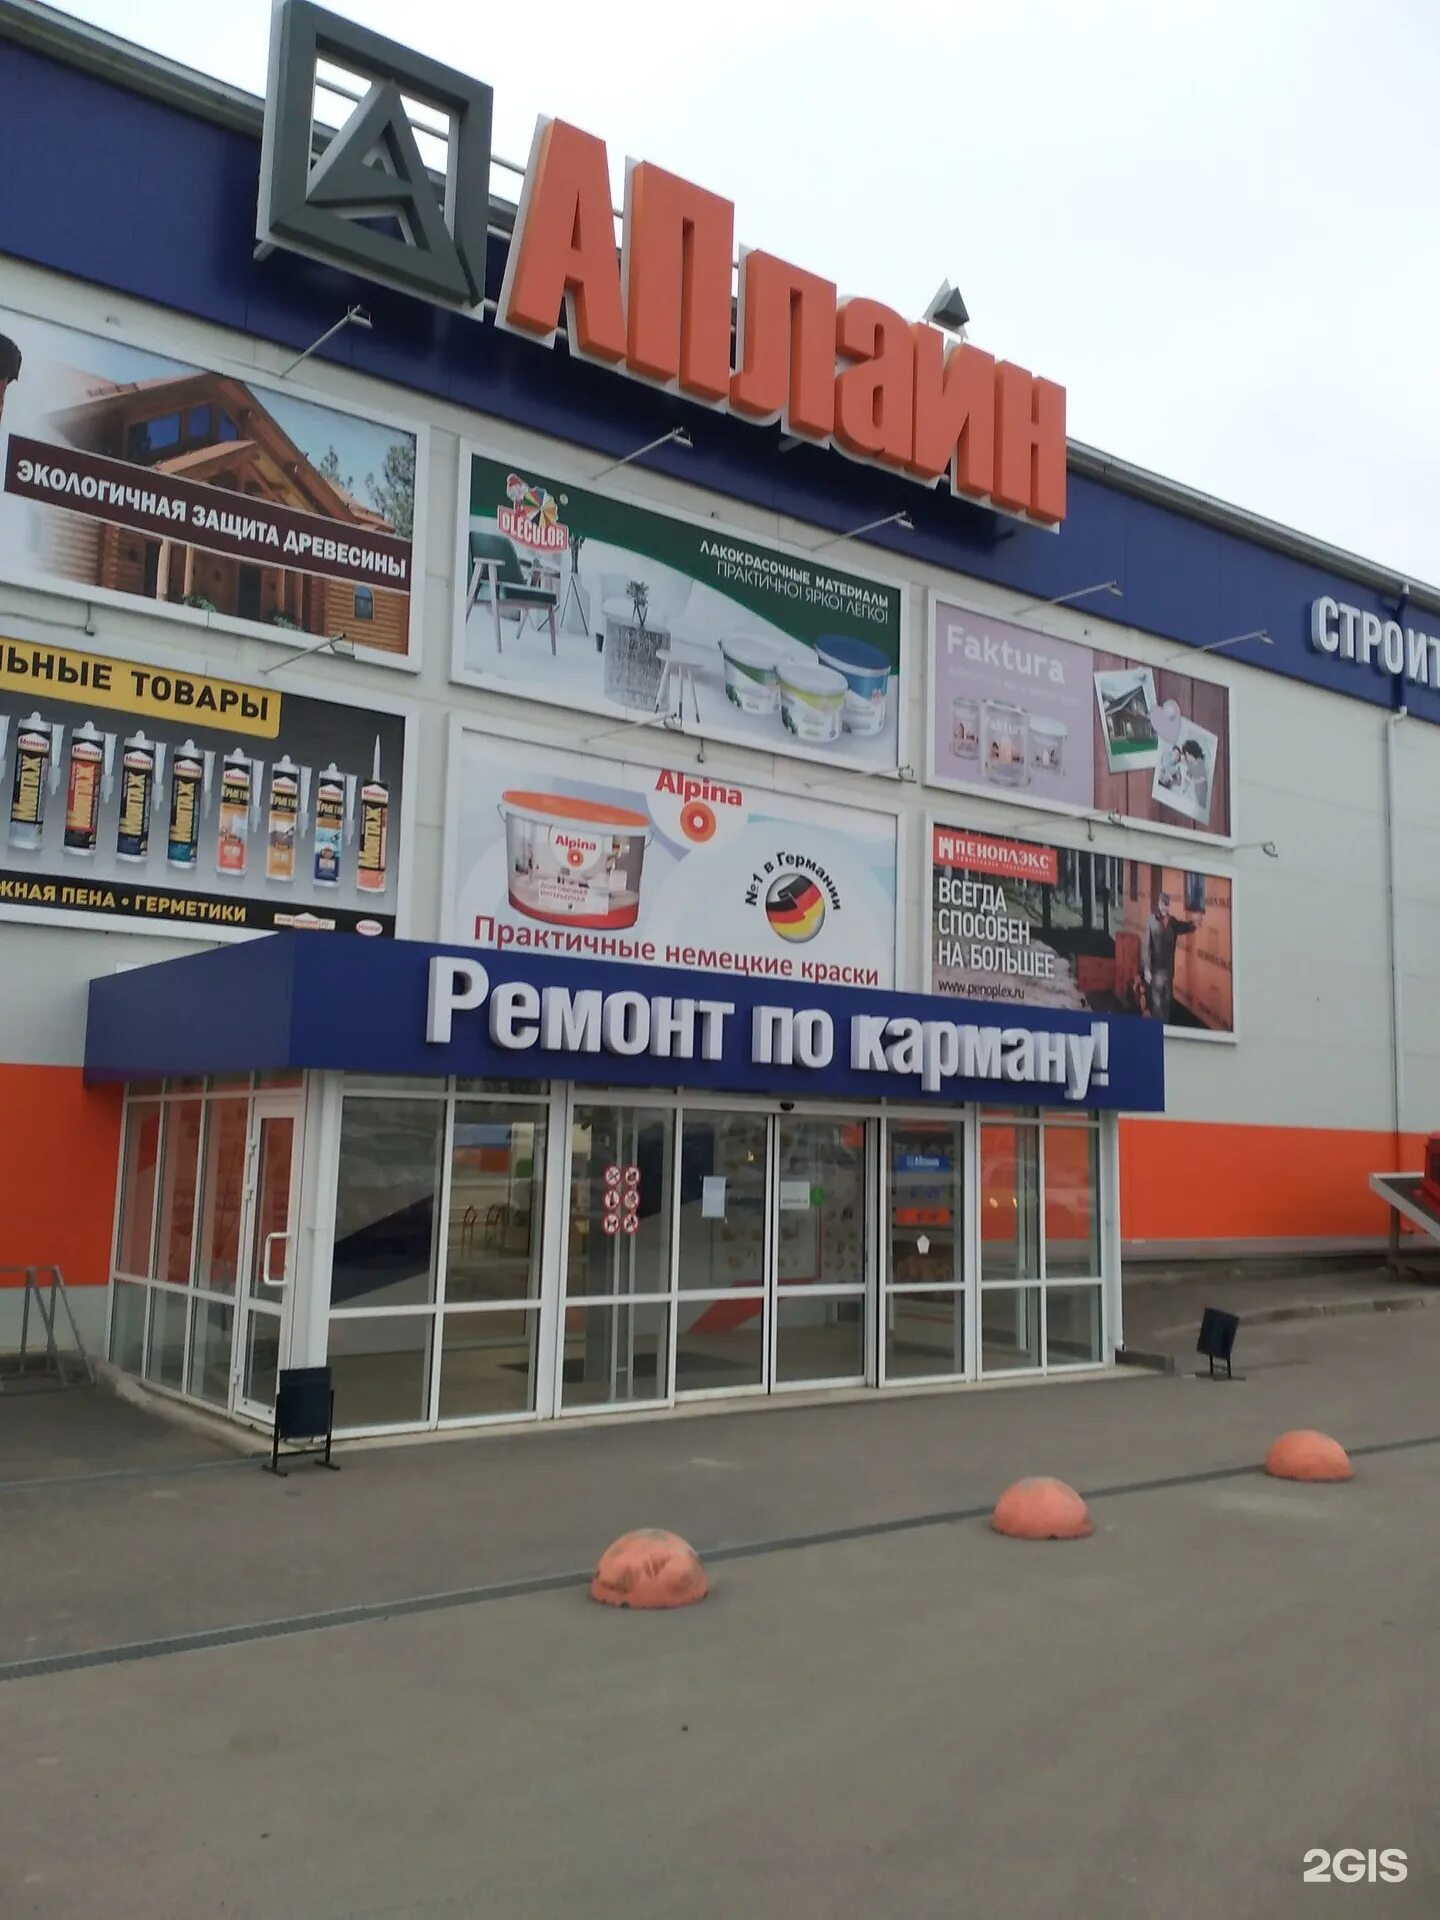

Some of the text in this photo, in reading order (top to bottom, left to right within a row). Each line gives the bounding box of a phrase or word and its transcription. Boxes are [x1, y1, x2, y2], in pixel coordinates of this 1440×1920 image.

[16, 459, 407, 578] ЭКОЛОГИЧНАЯ ЗАЩИТА ДРЕВЕСИНЫ
[700, 540, 888, 609] ЛАКОКРАСОЧНЫЕ МАТЕРИАЛЫ
[947, 624, 1065, 684] Faktura
[0, 645, 269, 721] ЬНЫЕ ТОВАРЫ
[655, 768, 742, 806] Alpina
[555, 834, 596, 851] Alpina
[956, 839, 1049, 869] ПЕНОПЛЭКС
[744, 852, 840, 910] №1 в Германии
[939, 877, 1007, 914] ВСЕГДА
[61, 887, 115, 908] ПЕНА
[134, 894, 246, 922] ГЕРМЕТИКИ
[939, 908, 1030, 945] СПОСОБЕН
[474, 915, 878, 986] Практичные немецкие краски
[939, 940, 1055, 978] НА БОЛЬШЕЕ
[939, 980, 1025, 999] www.penoplex.ru
[426, 955, 1110, 1100] Ремонт по карману!
